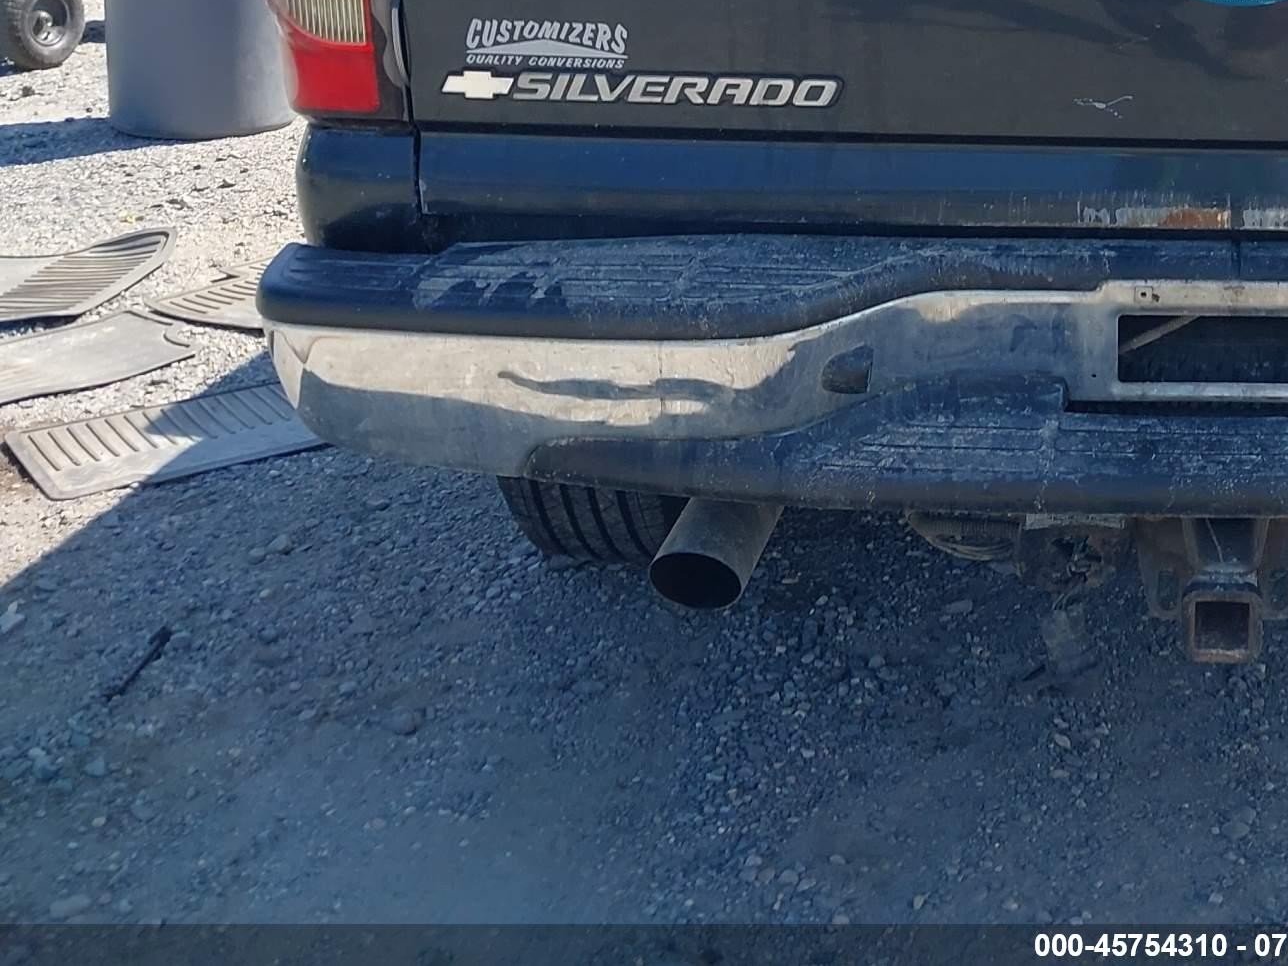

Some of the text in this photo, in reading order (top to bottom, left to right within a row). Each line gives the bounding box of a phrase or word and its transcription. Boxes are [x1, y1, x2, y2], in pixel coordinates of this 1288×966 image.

[465, 18, 628, 54] CUSTOMIZERS
[465, 54, 626, 69] QUALITY CONVERSIONS
[512, 71, 838, 109] SILVERADO
